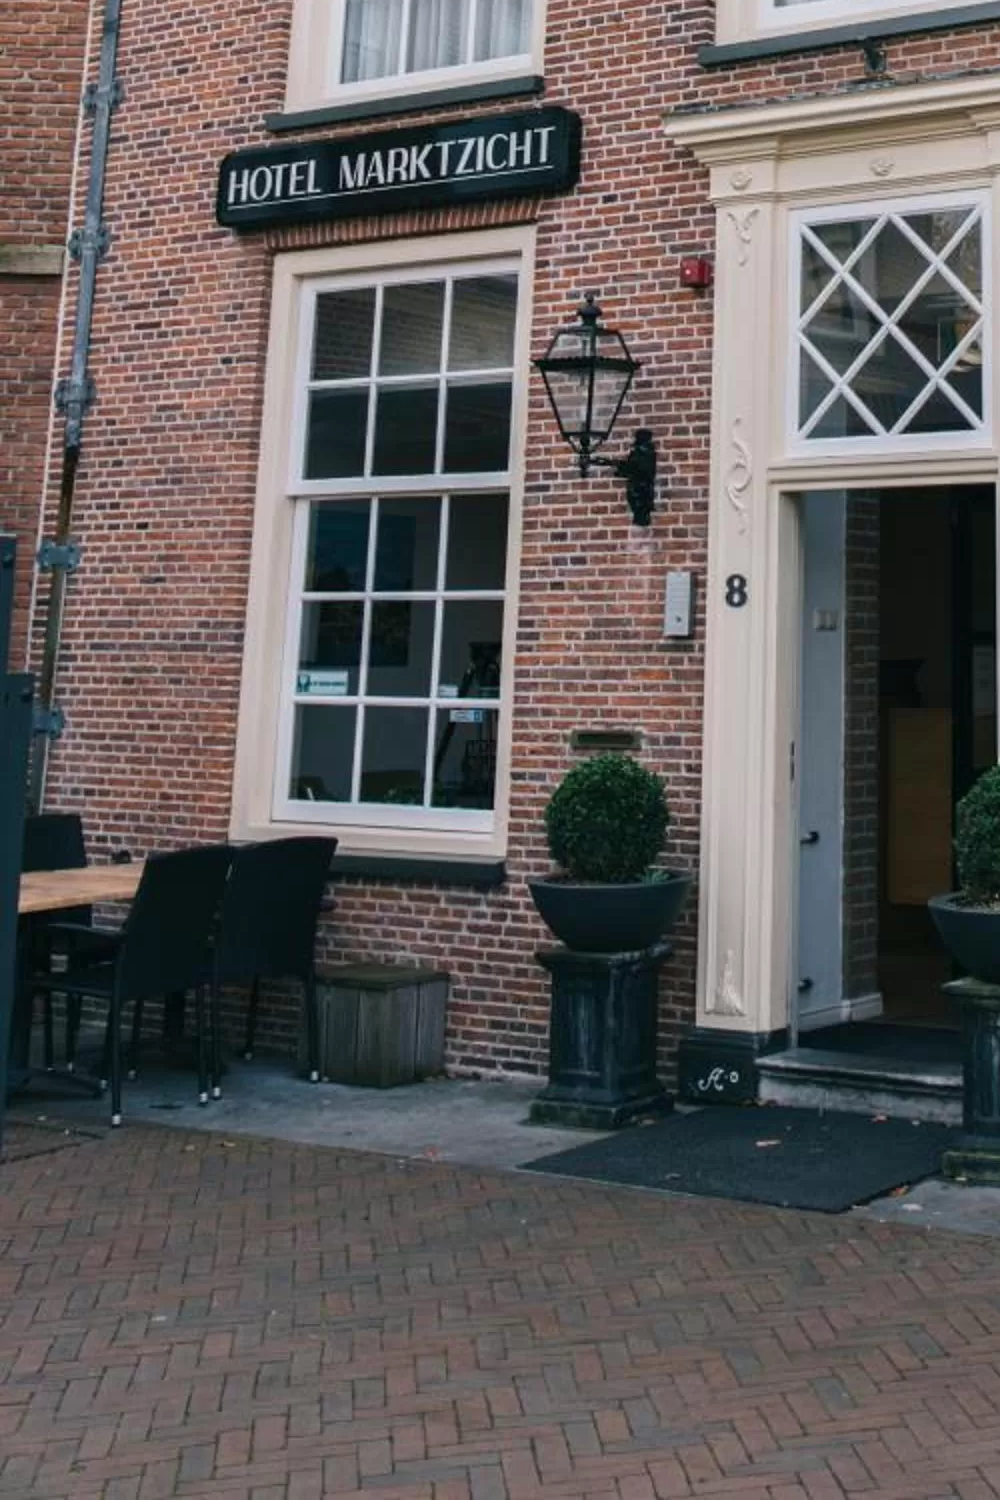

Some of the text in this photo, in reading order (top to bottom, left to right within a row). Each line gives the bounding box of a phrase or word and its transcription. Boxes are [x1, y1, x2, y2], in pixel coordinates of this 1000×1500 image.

[227, 126, 556, 204] HOTEL MARKTZICHT
[725, 573, 748, 609] 8
